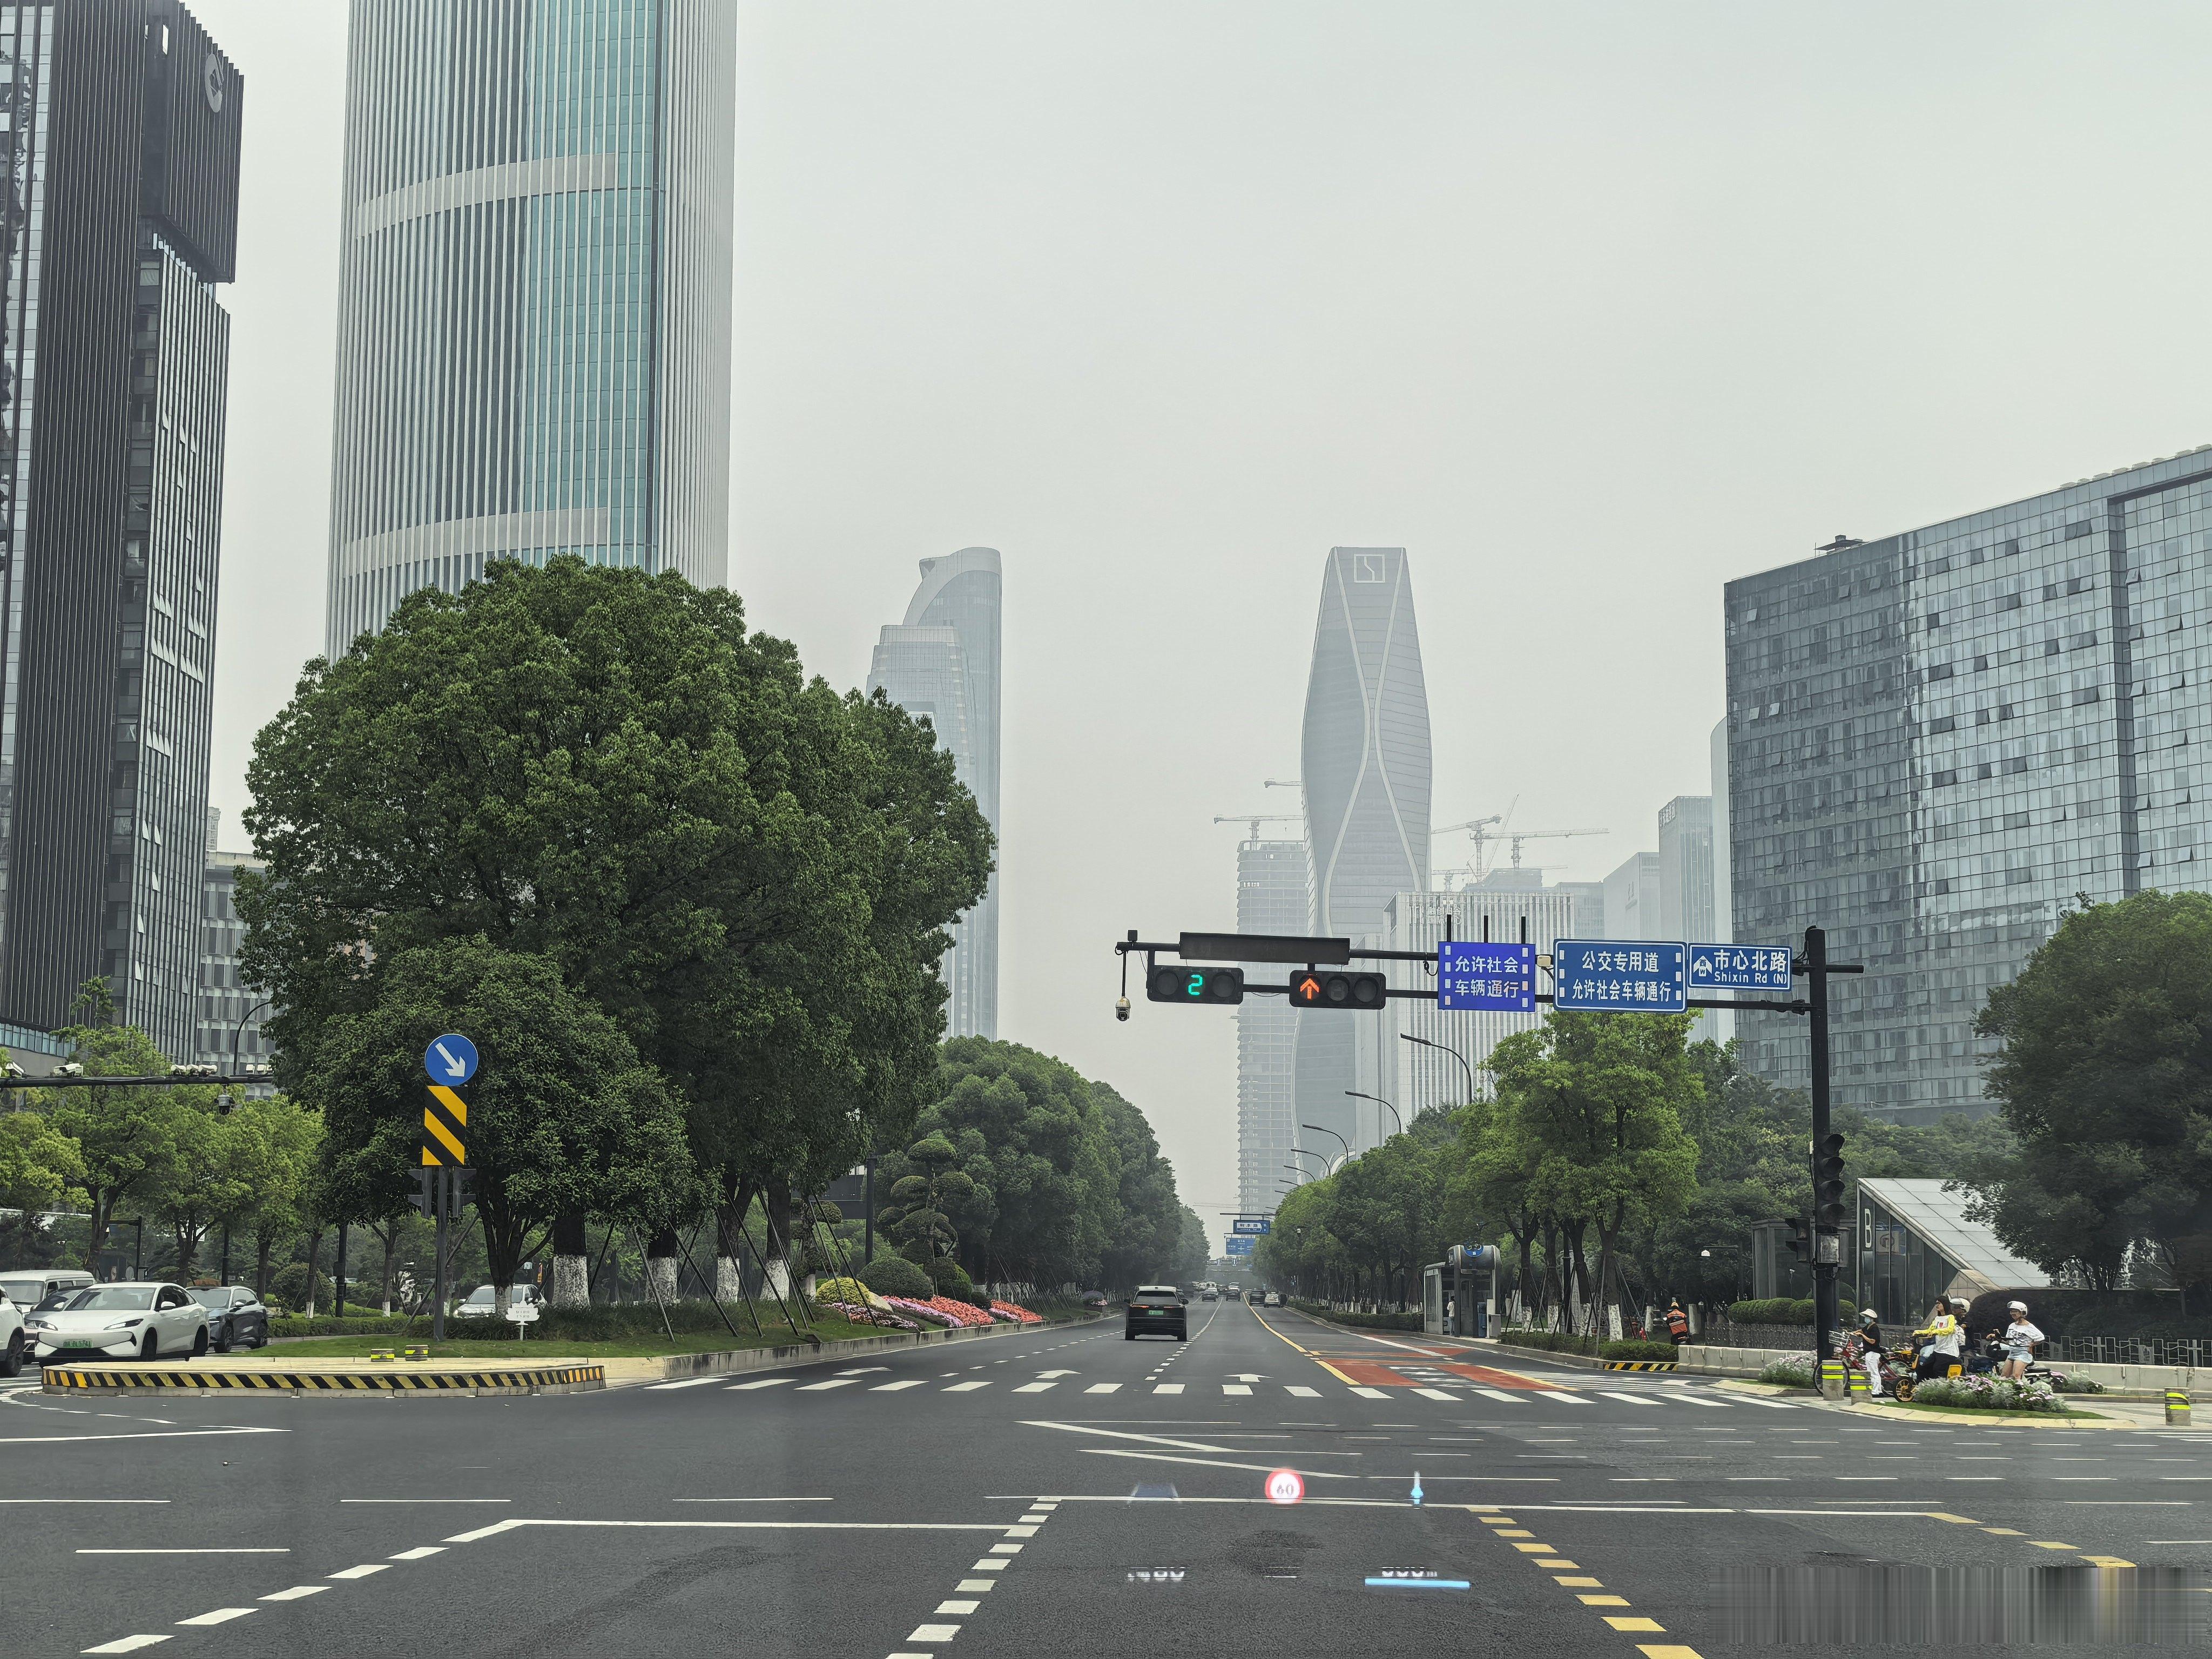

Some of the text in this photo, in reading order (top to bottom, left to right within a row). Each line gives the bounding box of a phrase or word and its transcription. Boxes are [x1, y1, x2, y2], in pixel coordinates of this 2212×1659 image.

[1455, 955, 1518, 973] 允许社会
[1582, 950, 1659, 972] 公交专用道
[1714, 949, 1787, 973] 市心北路
[1188, 974, 1203, 995] 2
[1714, 971, 1787, 984] Shixin Rd (N)
[1455, 979, 1519, 998] 车辆通行
[1572, 979, 1671, 1002] 允许社会车辆通行
[1864, 1208, 1872, 1248] B
[1277, 1483, 1294, 1496] 60
